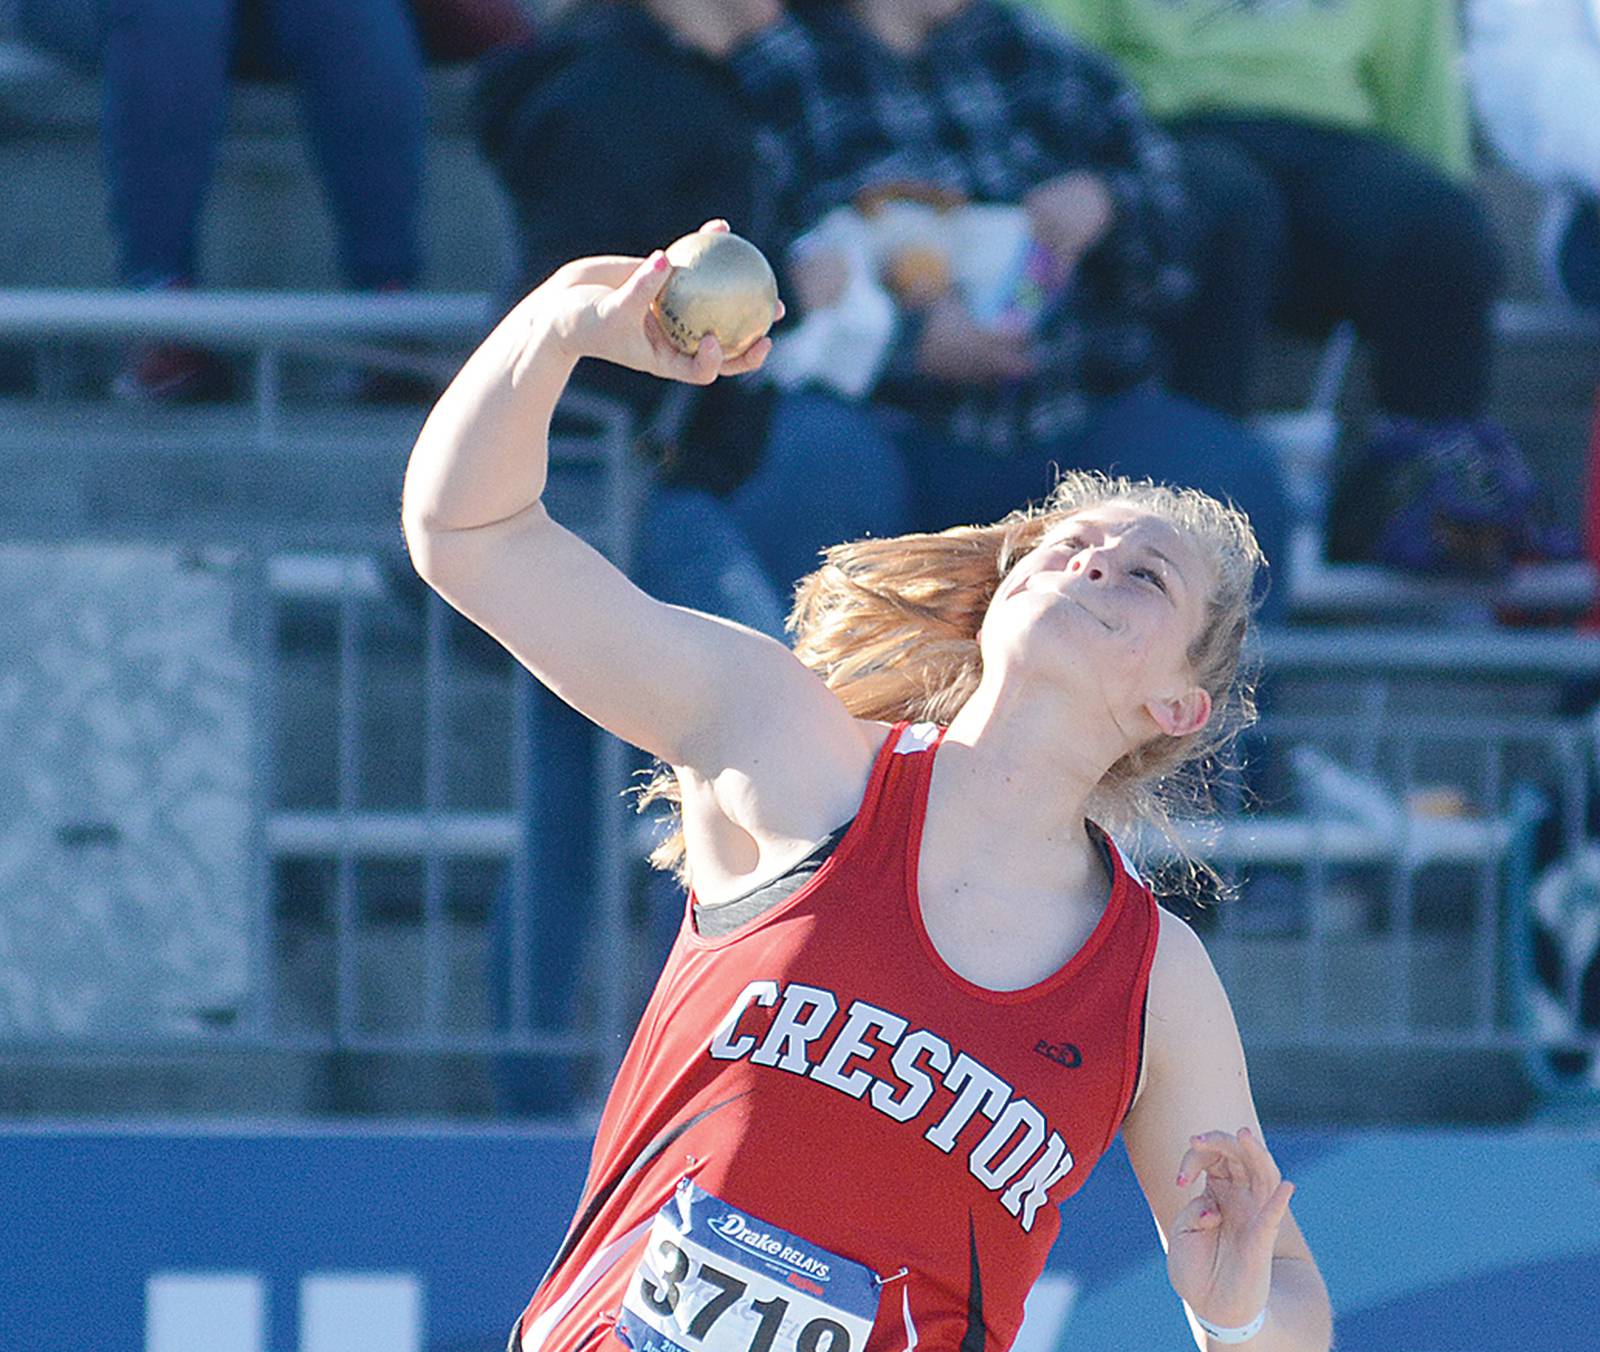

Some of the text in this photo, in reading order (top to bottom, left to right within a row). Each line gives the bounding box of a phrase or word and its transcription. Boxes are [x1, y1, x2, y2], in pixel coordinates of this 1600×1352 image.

[709, 981, 1074, 1233] CRESTON
[719, 1214, 829, 1277] Drake RELAYS
